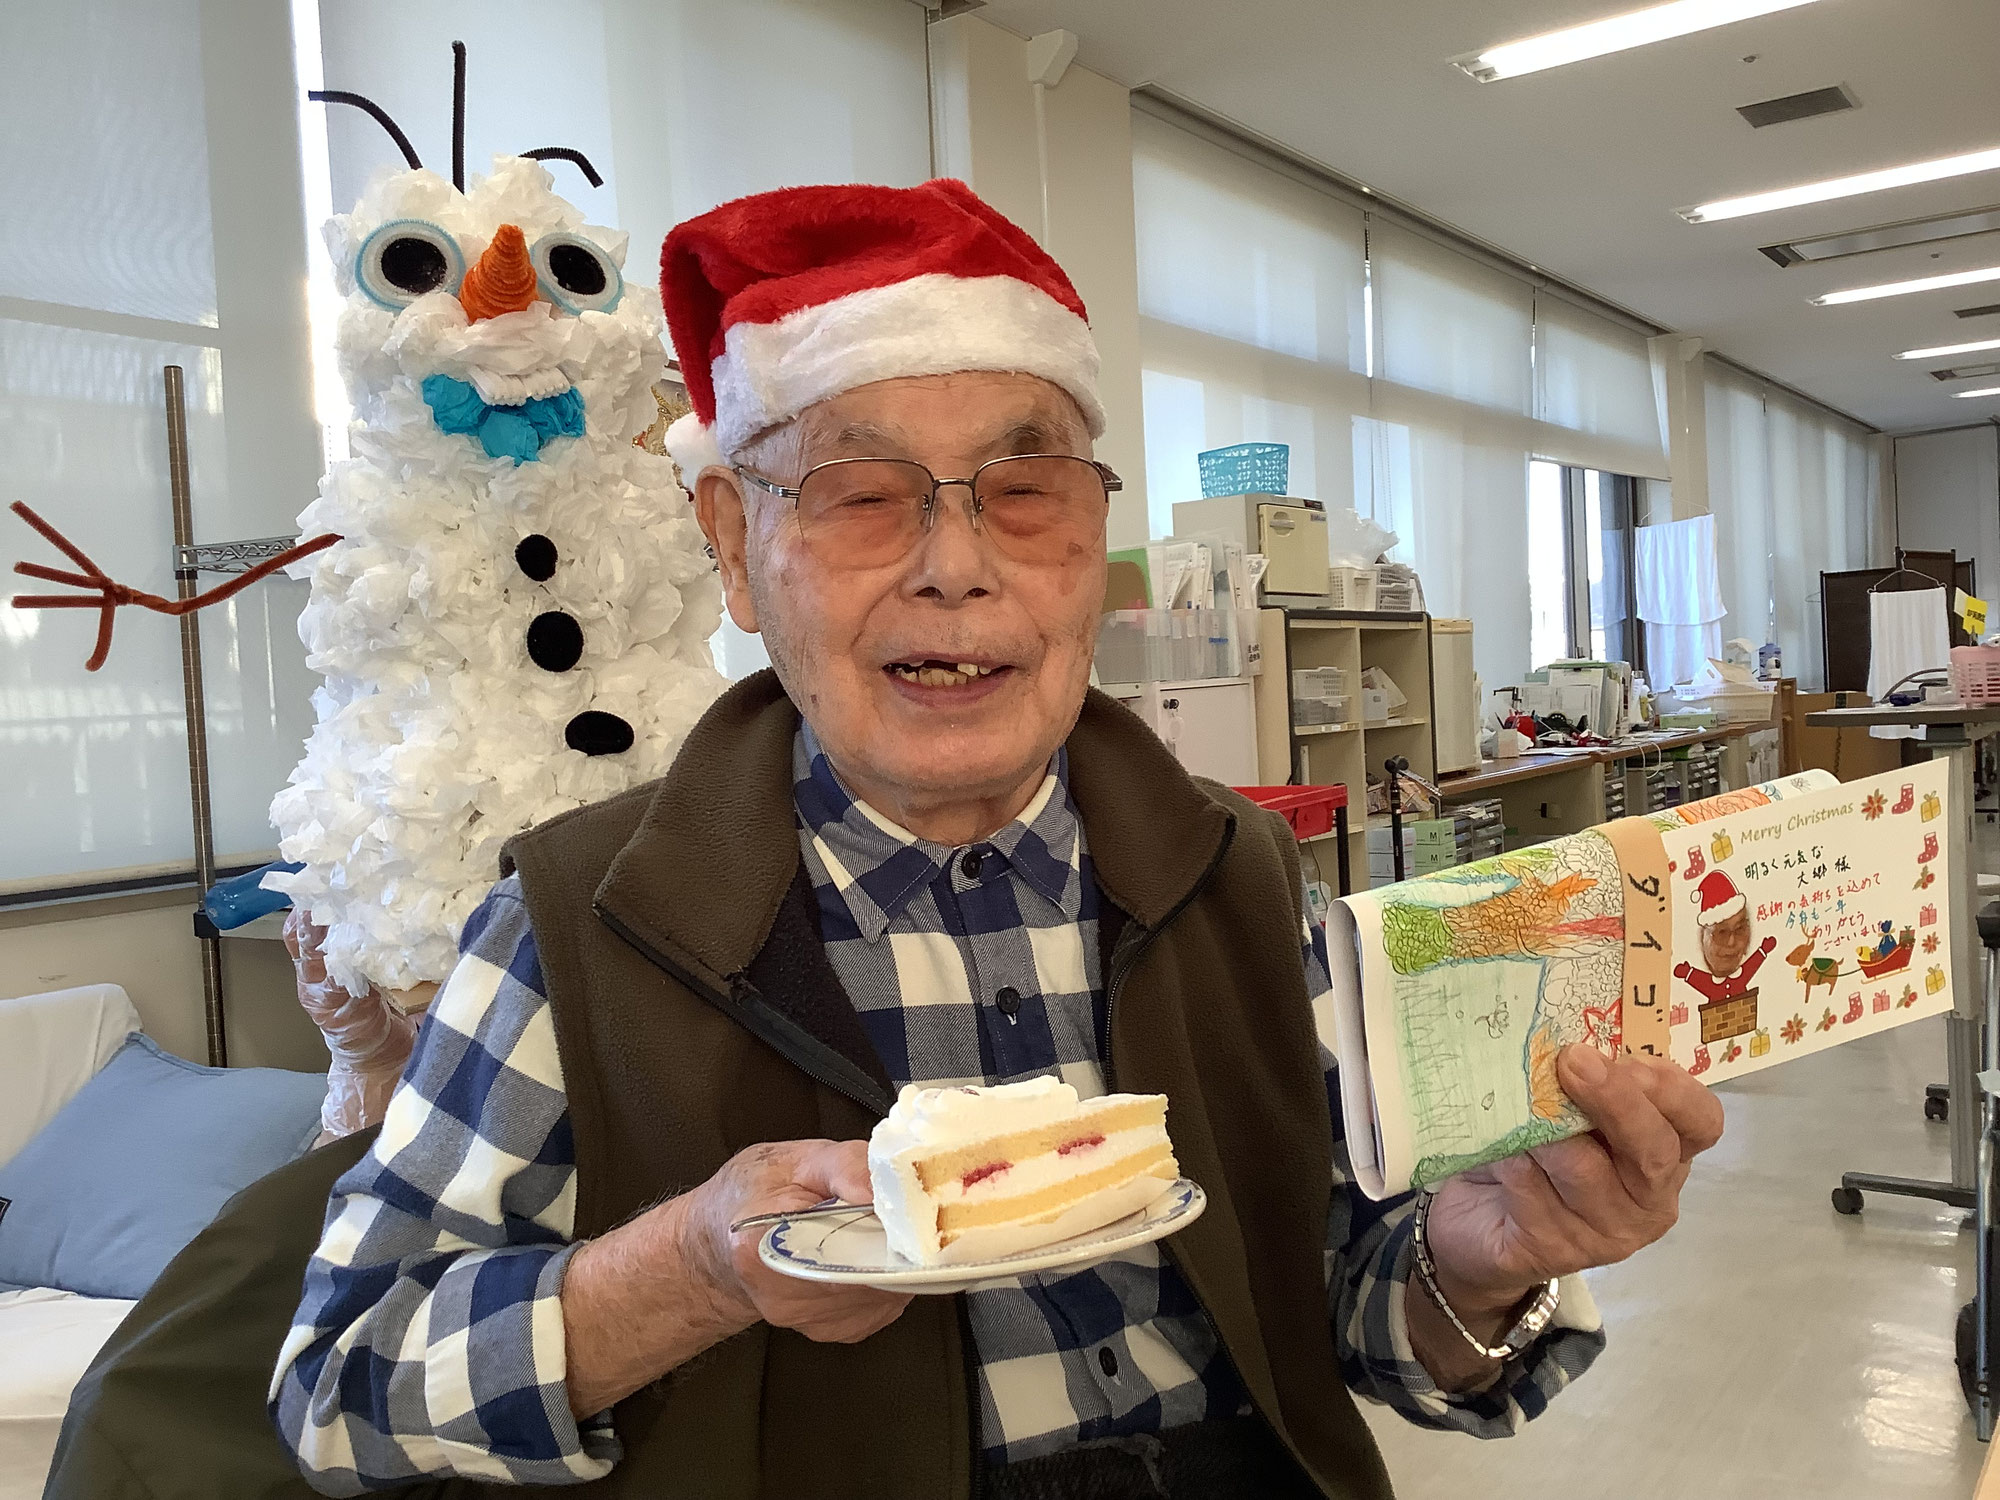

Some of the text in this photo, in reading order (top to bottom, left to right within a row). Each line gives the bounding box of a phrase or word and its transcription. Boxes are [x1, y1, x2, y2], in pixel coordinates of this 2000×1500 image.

[1740, 802, 1854, 844] Merry Christmas
[1744, 845, 1824, 880] 明るく元気な
